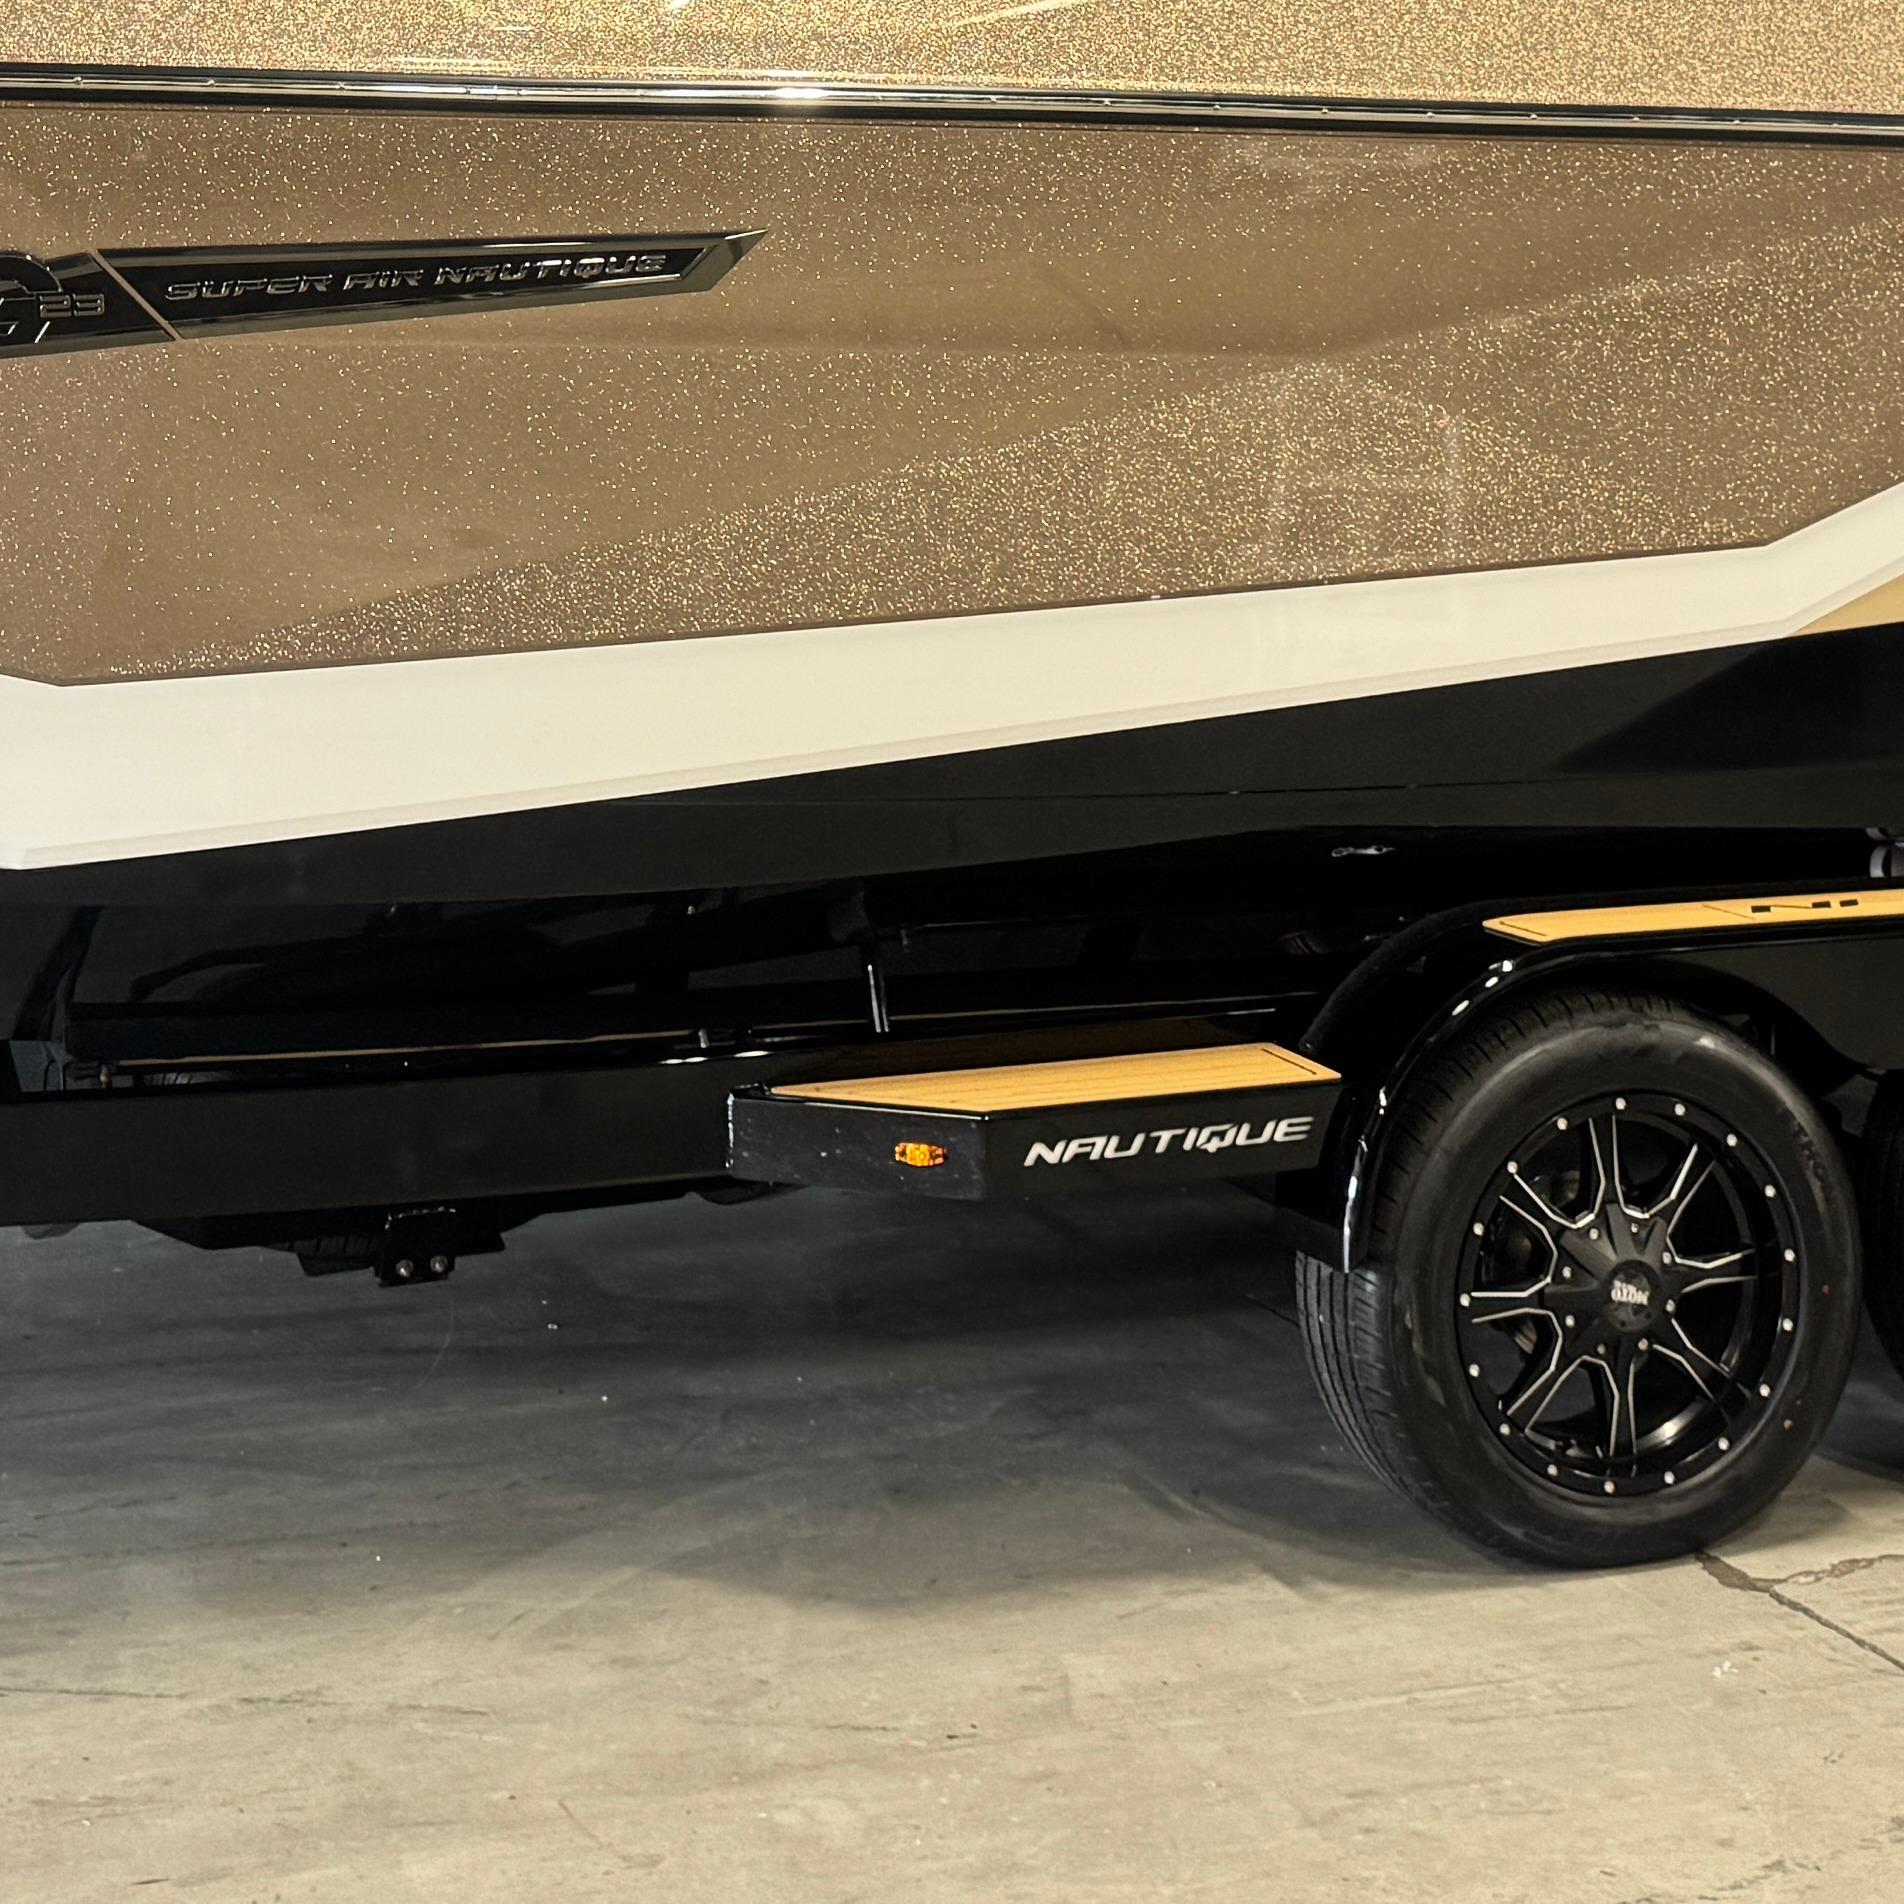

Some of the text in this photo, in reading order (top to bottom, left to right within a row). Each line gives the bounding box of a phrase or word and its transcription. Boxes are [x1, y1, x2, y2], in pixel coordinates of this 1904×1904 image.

[165, 273, 334, 301] SUPER
[342, 268, 425, 291] AIR
[433, 254, 667, 287] NAUTIQUE
[1022, 1115, 1315, 1168] NAUTIQUE
